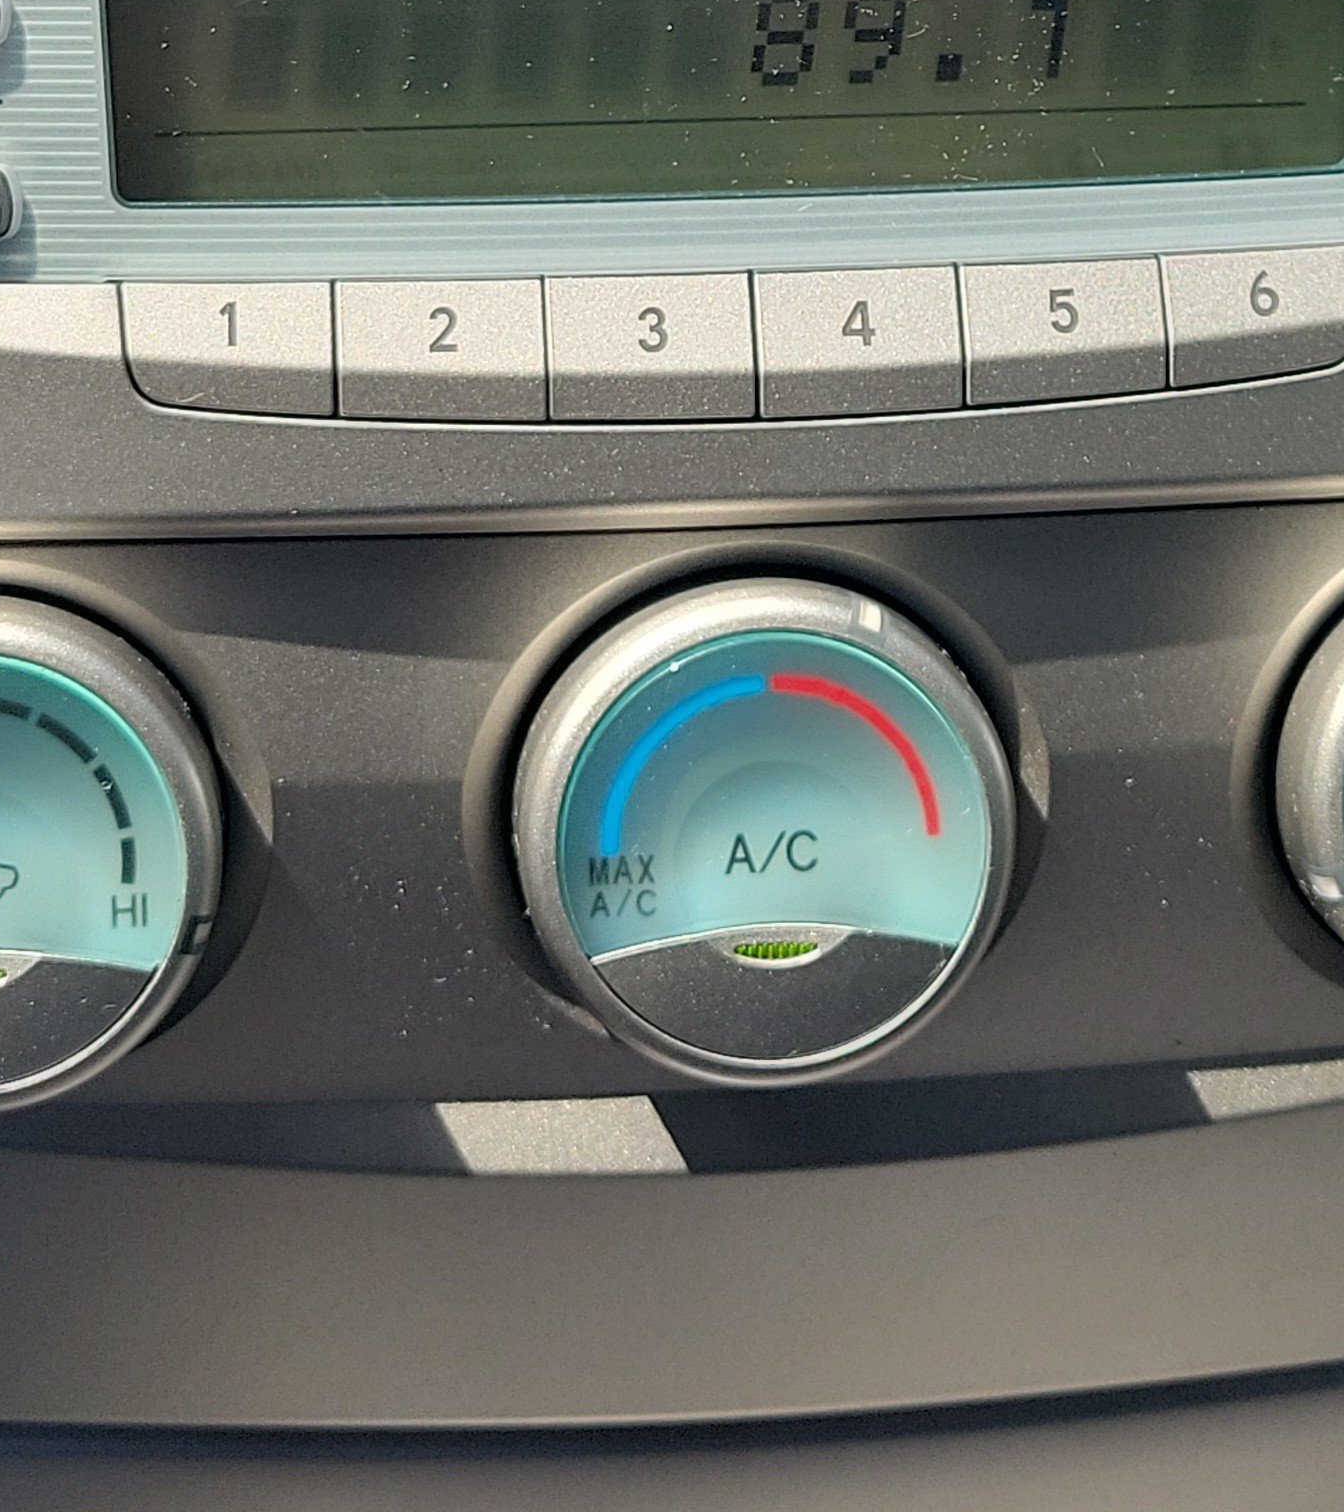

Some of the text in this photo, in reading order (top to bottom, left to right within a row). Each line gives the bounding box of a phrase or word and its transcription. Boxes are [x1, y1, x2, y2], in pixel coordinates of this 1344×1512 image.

[1048, 287, 1080, 335] 5
[1248, 270, 1282, 318] 6
[217, 302, 239, 348] 1
[428, 307, 460, 354] 2
[637, 306, 670, 354] 3
[841, 299, 876, 349] 4
[589, 854, 655, 887] MAX
[725, 828, 820, 876] A/C
[111, 892, 148, 929] HI
[590, 889, 657, 919] A/C
